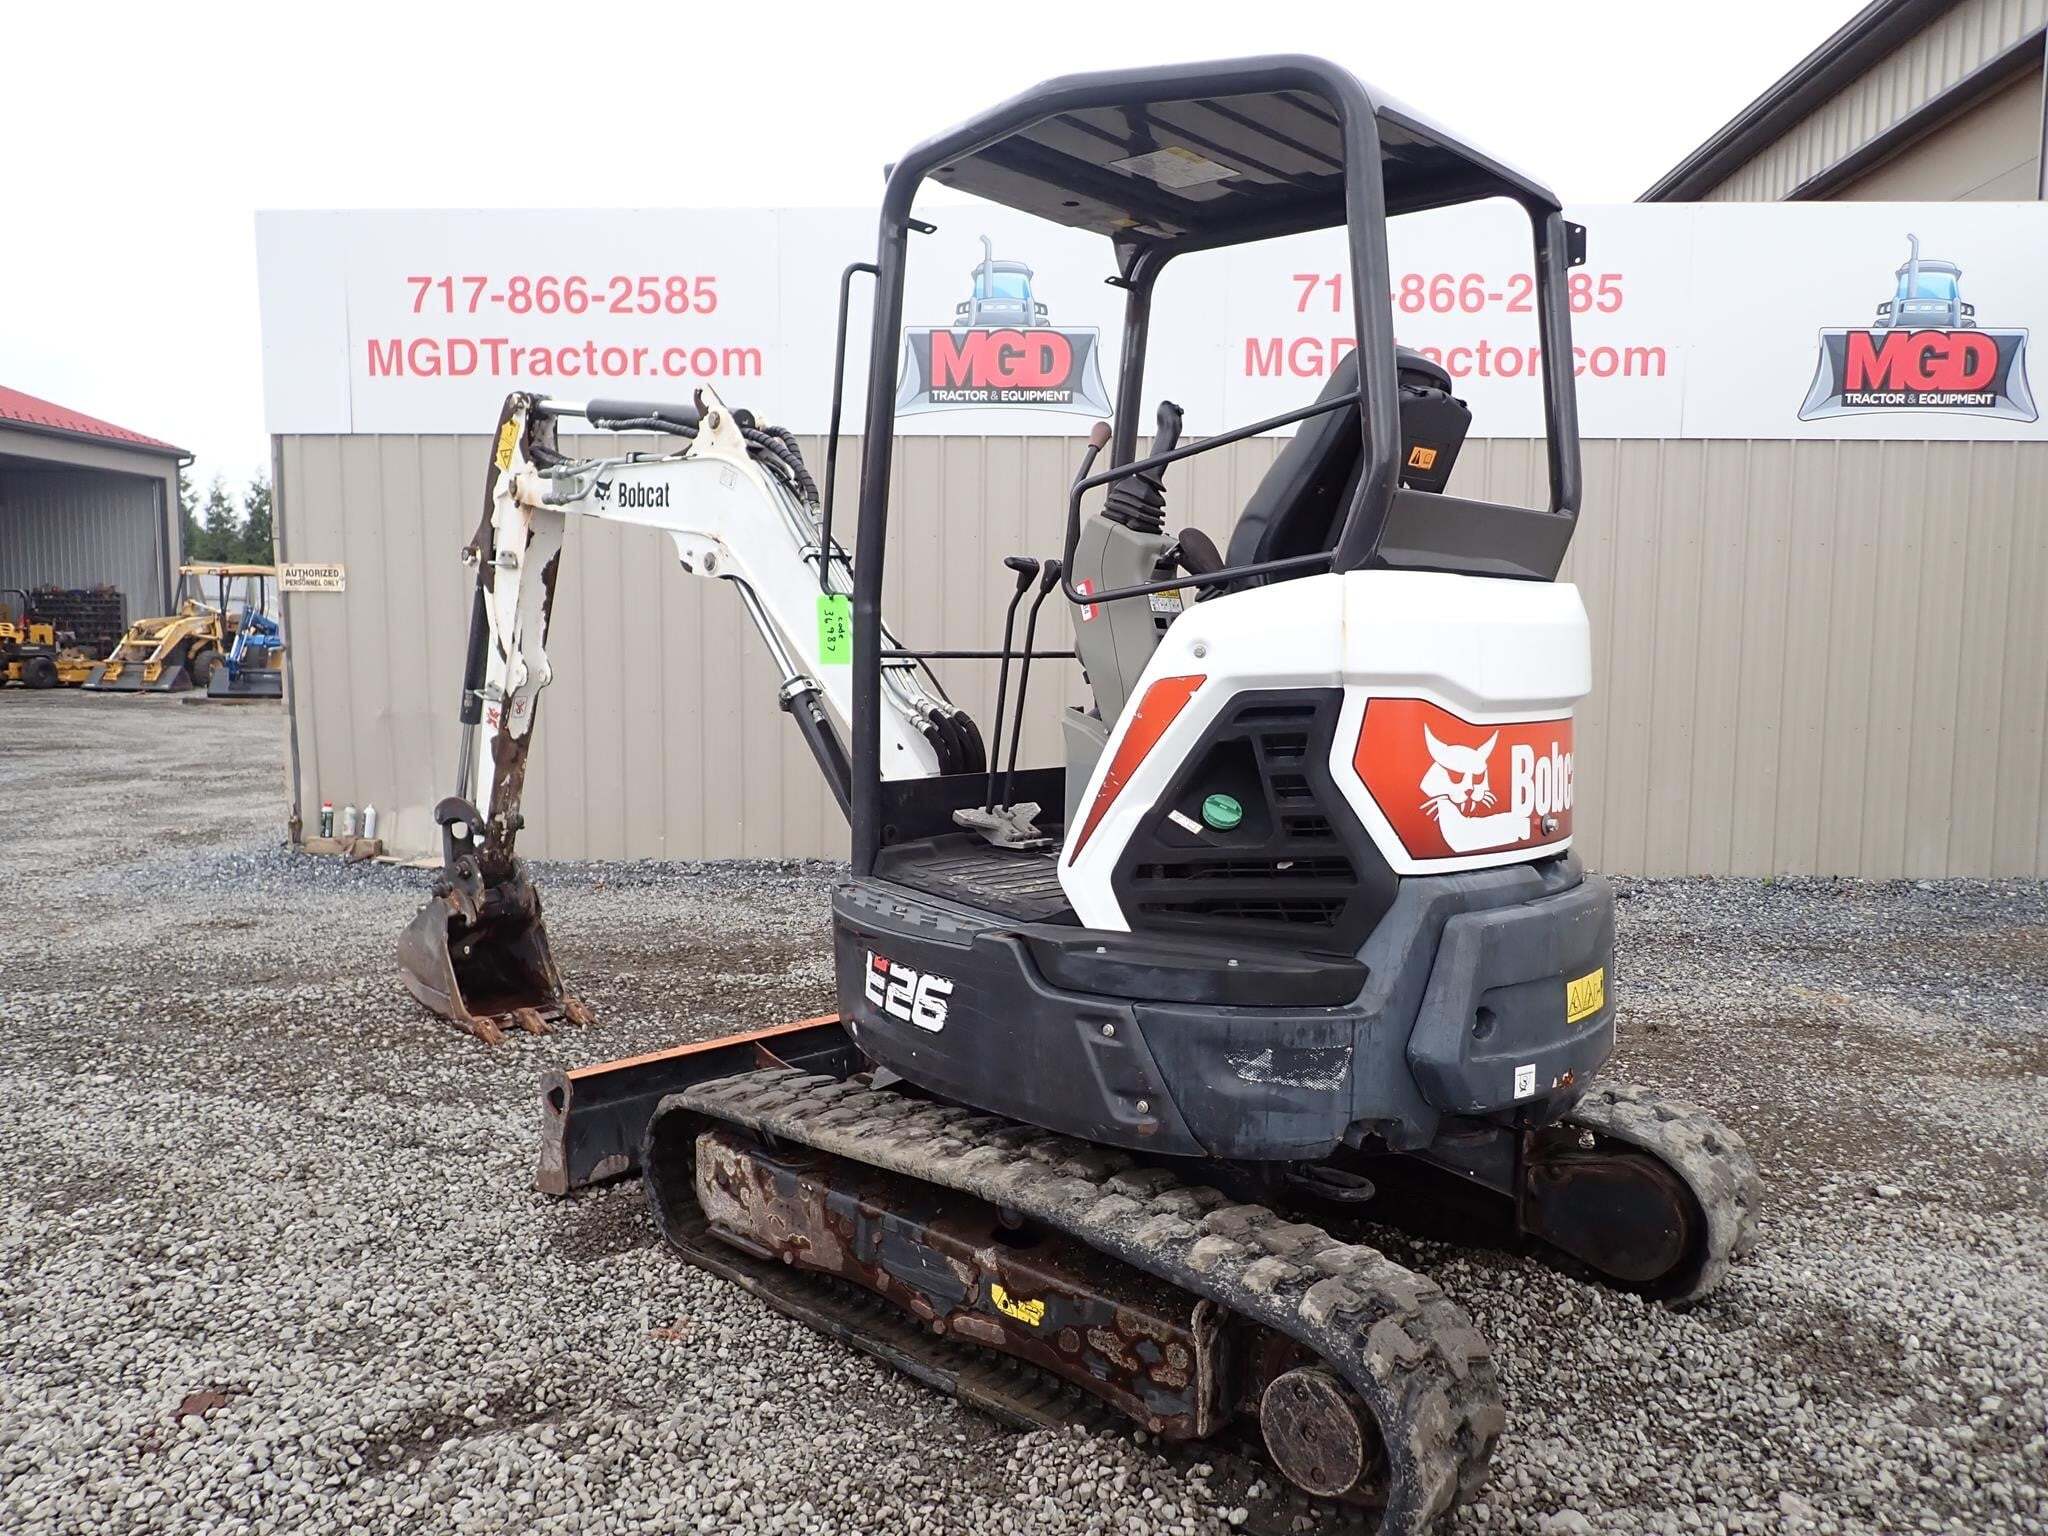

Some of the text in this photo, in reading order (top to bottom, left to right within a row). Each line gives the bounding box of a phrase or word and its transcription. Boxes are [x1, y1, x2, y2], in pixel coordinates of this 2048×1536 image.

[407, 276, 718, 314] 717-866-2585
[1293, 273, 1623, 313] 71866-285
[368, 337, 762, 377] MGDTractor.com
[930, 329, 1072, 388] MGD
[1845, 329, 1999, 391] MGD
[932, 390, 1071, 401] TRACTOR & EQUIPMENT
[1845, 393, 1994, 405] TRACTOR & EQUIPMENT
[618, 482, 670, 508] Bobcat
[285, 569, 339, 577] AUTHORIZED
[285, 579, 339, 587] PERSONNEL ONLY
[865, 950, 954, 1033] E26
